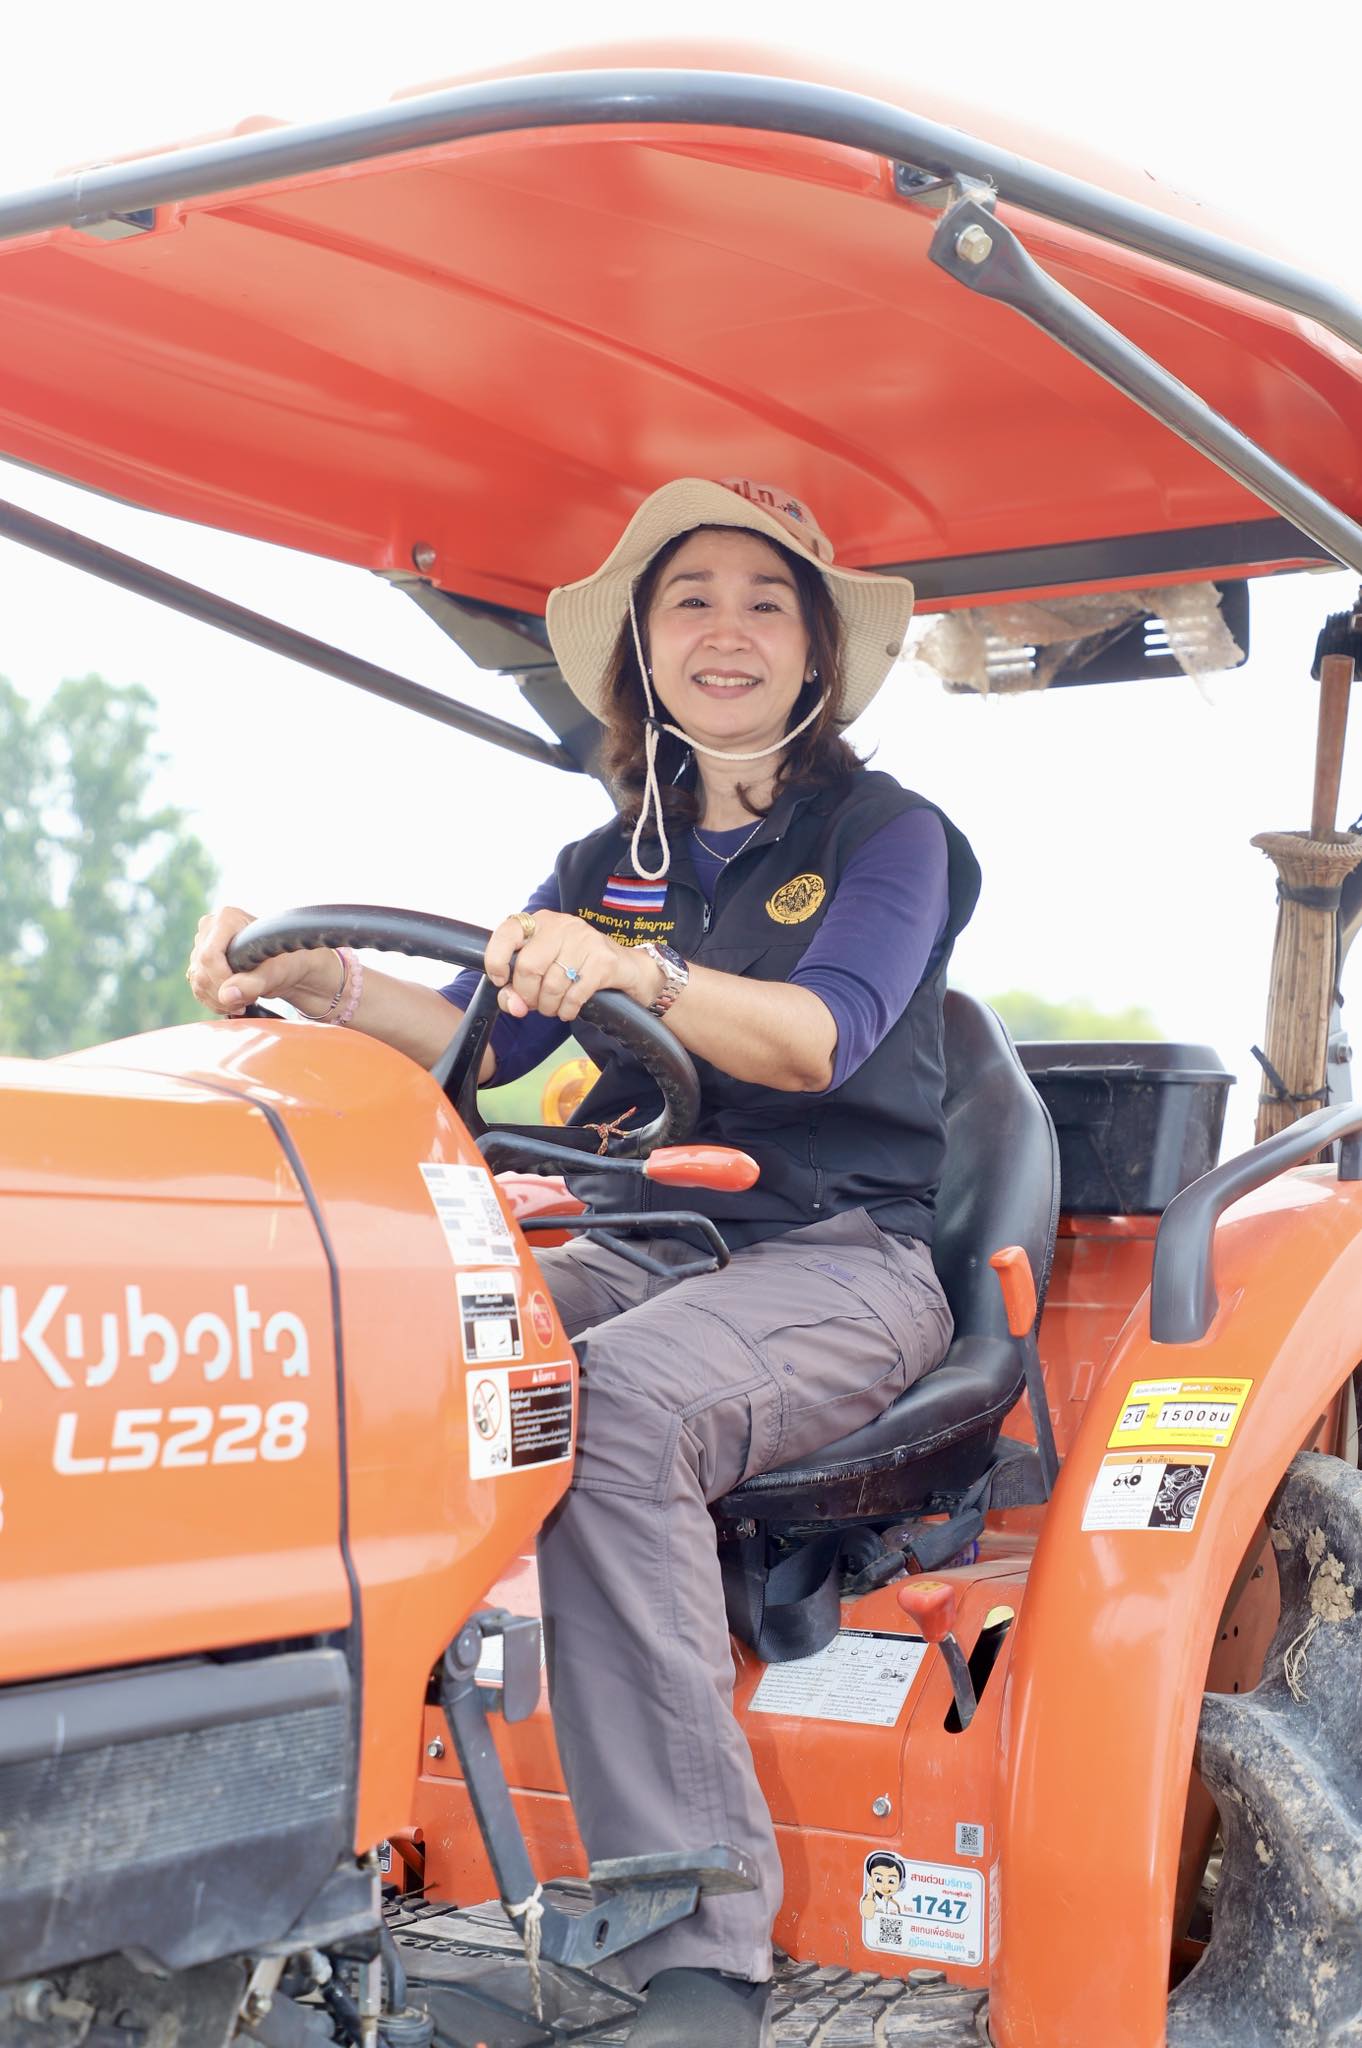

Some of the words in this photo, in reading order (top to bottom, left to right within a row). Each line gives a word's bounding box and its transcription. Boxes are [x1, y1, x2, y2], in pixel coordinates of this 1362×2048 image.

[1, 1284, 311, 1388] Kubota
[52, 1400, 309, 1476] L5228
[912, 1894, 967, 1920] 1747
